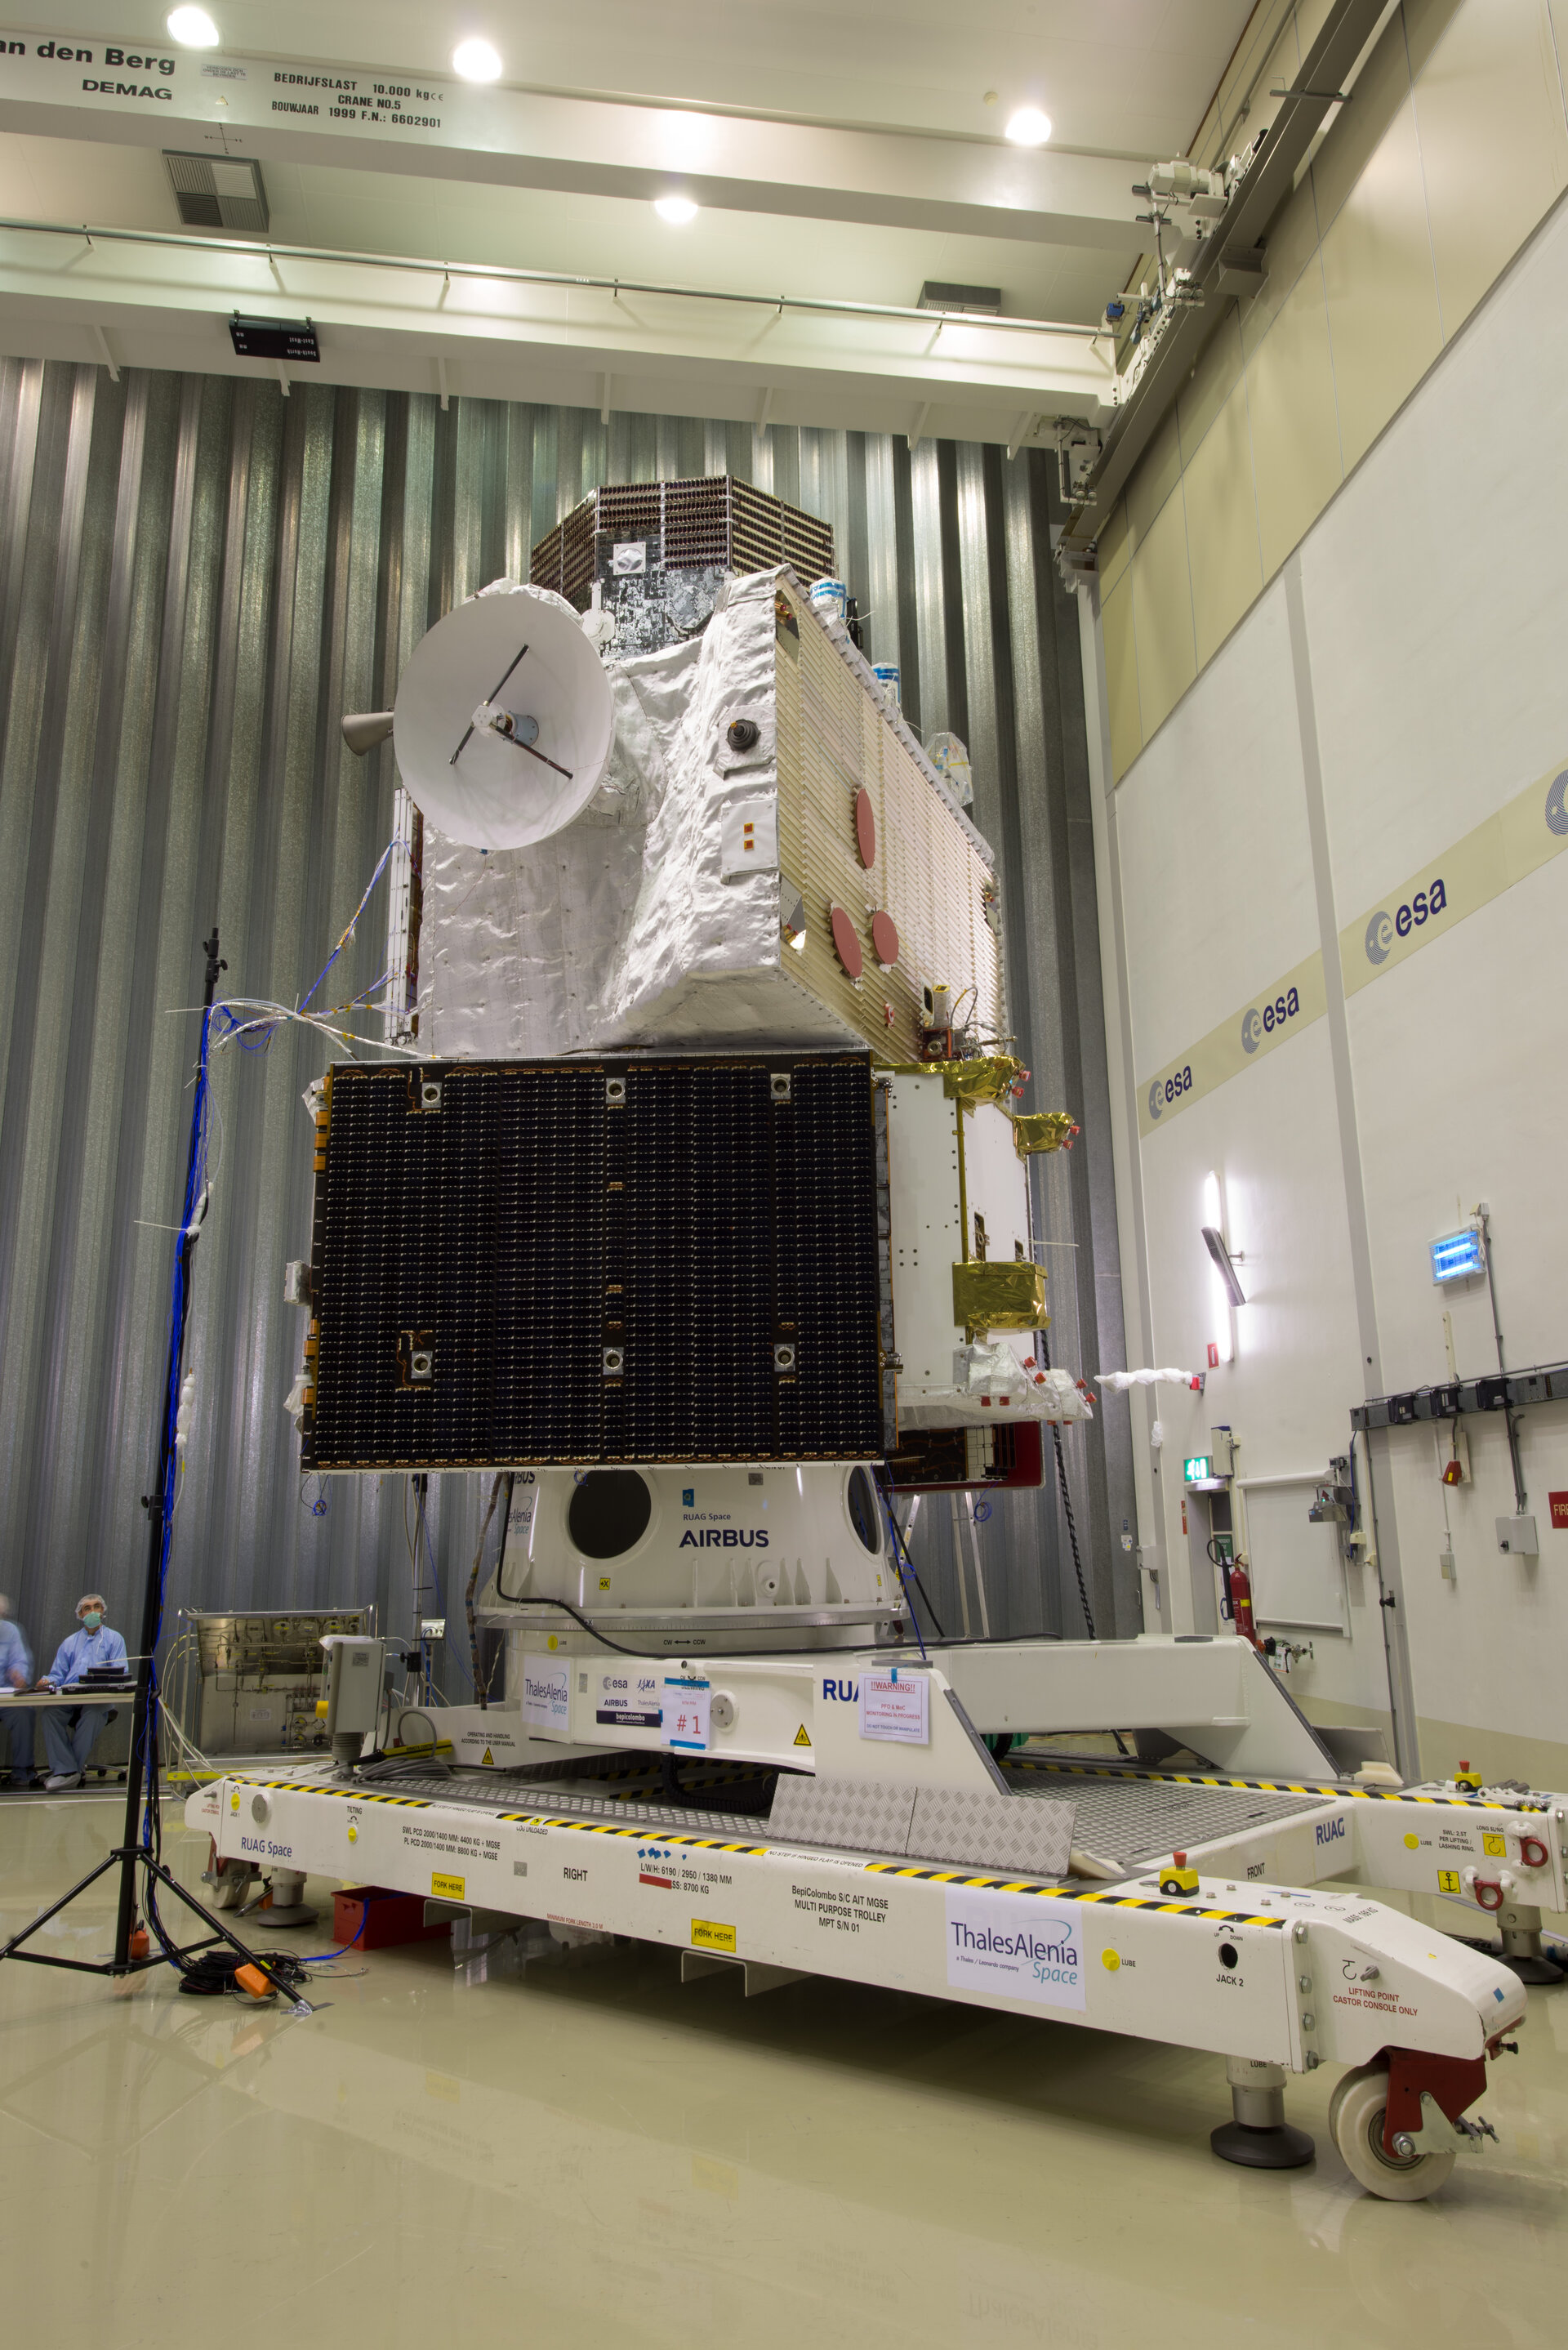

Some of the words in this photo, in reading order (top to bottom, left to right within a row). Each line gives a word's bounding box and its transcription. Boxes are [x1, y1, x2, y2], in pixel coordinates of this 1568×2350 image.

[37, 42, 93, 63] den
[105, 47, 176, 75] Berg
[82, 79, 173, 100] DEMAG
[274, 72, 358, 91] BEDRIJFSLAST
[372, 83, 412, 97] 10.000
[416, 88, 430, 100] kg
[337, 94, 373, 107] CRANE
[376, 98, 401, 110] NO.5
[271, 100, 319, 116] BOUWJAAR
[329, 107, 356, 119] 1999
[361, 110, 386, 123] F.N.:
[391, 114, 441, 128] 6602901
[1395, 878, 1447, 937] esa
[1263, 986, 1300, 1032] esa
[1165, 1064, 1193, 1104] esa
[683, 1513, 706, 1521] RUAG
[708, 1513, 731, 1522] Space
[679, 1529, 769, 1548] AIRBUS
[524, 1679, 568, 1702] ThalesAlenia
[612, 1679, 628, 1688] esa
[871, 1681, 915, 1692] !!WARNING!!
[551, 1701, 568, 1715] Space
[604, 1699, 628, 1707] AIRBUS
[676, 1715, 687, 1732] #
[693, 1715, 701, 1734] 1
[347, 1805, 363, 1815] TILTING
[402, 1826, 412, 1835] SWL
[412, 1827, 423, 1836] PCD
[423, 1829, 448, 1840] 2000/1400
[448, 1833, 460, 1842] MM:
[460, 1835, 472, 1844] 4400
[472, 1838, 480, 1846] KG
[485, 1839, 501, 1850] MGSE
[525, 1827, 549, 1835] UNLOADED
[1316, 1817, 1345, 1846] RUAG
[241, 1836, 265, 1853] RUAG
[268, 1841, 292, 1857] Space
[403, 1837, 410, 1846] PL
[410, 1838, 421, 1848] PCD
[421, 1839, 445, 1852] 2000/1400
[446, 1843, 457, 1853] MM:
[457, 1846, 470, 1856] 8800
[470, 1848, 478, 1857] KG
[483, 1850, 498, 1861] MGSE
[1438, 1843, 1461, 1851] LASHING
[640, 1862, 660, 1875] L/W/H:
[661, 1866, 676, 1876] 6190
[681, 1870, 697, 1880] 2950
[702, 1872, 719, 1884] 1380
[719, 1875, 733, 1884] MM
[840, 1860, 863, 1869] OPENED
[1247, 1862, 1265, 1880] FRONT
[564, 1867, 588, 1882] RIGHT
[434, 1880, 448, 1889] FORK
[448, 1882, 463, 1893] HERE
[683, 1883, 699, 1893] 8700
[700, 1885, 710, 1894] KG
[792, 1885, 837, 1901] BepiColombo
[838, 1893, 850, 1903] S/C
[853, 1895, 865, 1906] AIT
[866, 1897, 889, 1910] MGSE
[795, 1899, 817, 1911] MULTI
[818, 1902, 852, 1918] PURPOSE
[853, 1909, 886, 1923] TROLLEY
[546, 1913, 565, 1922] MINIMUM
[565, 1917, 577, 1925] FORK
[576, 1920, 591, 1928] LENGTH
[819, 1917, 835, 1929] MPT
[836, 1920, 849, 1931] S/N
[851, 1924, 860, 1933] 01
[694, 1928, 712, 1939] FORK
[714, 1932, 733, 1942] HERE
[951, 1921, 1078, 1966] ThalesAlenia
[960, 1955, 974, 1964] Thales
[978, 1960, 999, 1968] Leonardo
[999, 1964, 1019, 1973] company
[1121, 1959, 1136, 1968] LUBE
[1032, 1961, 1078, 1986] Space
[1216, 1973, 1237, 1987] JACK
[1239, 1978, 1245, 1987] 2
[1348, 1987, 1376, 1999] LIFTING
[1378, 1991, 1400, 2002] POINT
[1333, 1995, 1361, 2007] CASTOR
[1363, 2000, 1397, 2013] CONSOLE
[1399, 2006, 1419, 2017] ONLY
[1250, 2060, 1267, 2068] LUBE
